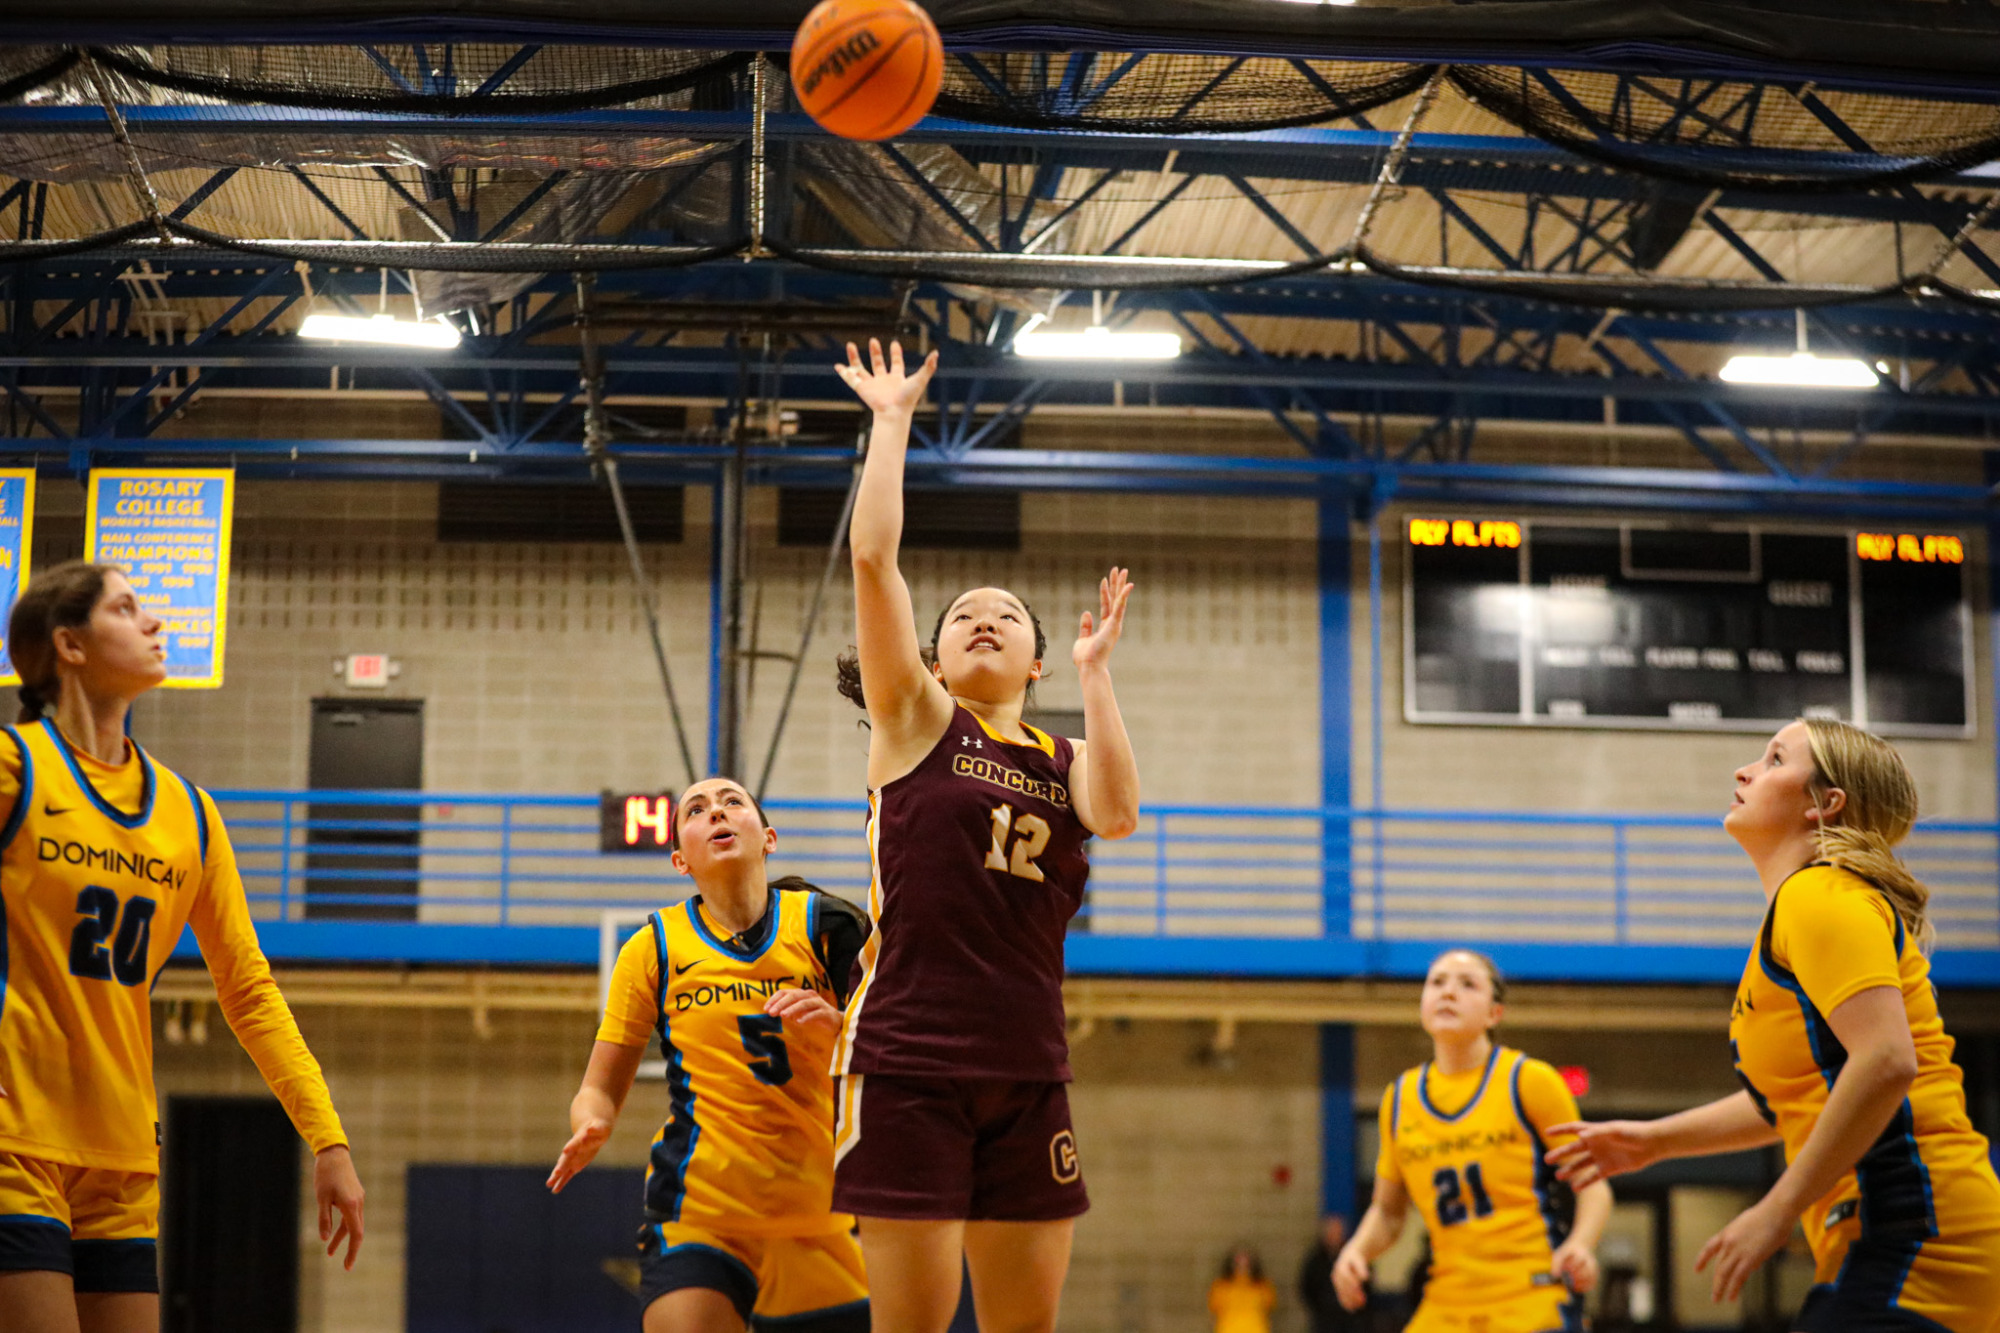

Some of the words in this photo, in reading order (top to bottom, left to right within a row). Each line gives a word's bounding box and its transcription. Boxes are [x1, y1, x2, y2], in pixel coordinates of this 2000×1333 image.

[115, 499, 205, 516] COLLEGE
[120, 480, 205, 497] ROSARY
[100, 546, 215, 562] CHAMPIONS
[952, 753, 1069, 809] CONCORD
[625, 796, 670, 845] 14
[984, 803, 1051, 883] 12
[69, 884, 157, 987] 20
[736, 1012, 794, 1086] 5
[1049, 1129, 1079, 1185] C
[1433, 1161, 1494, 1227] 21
